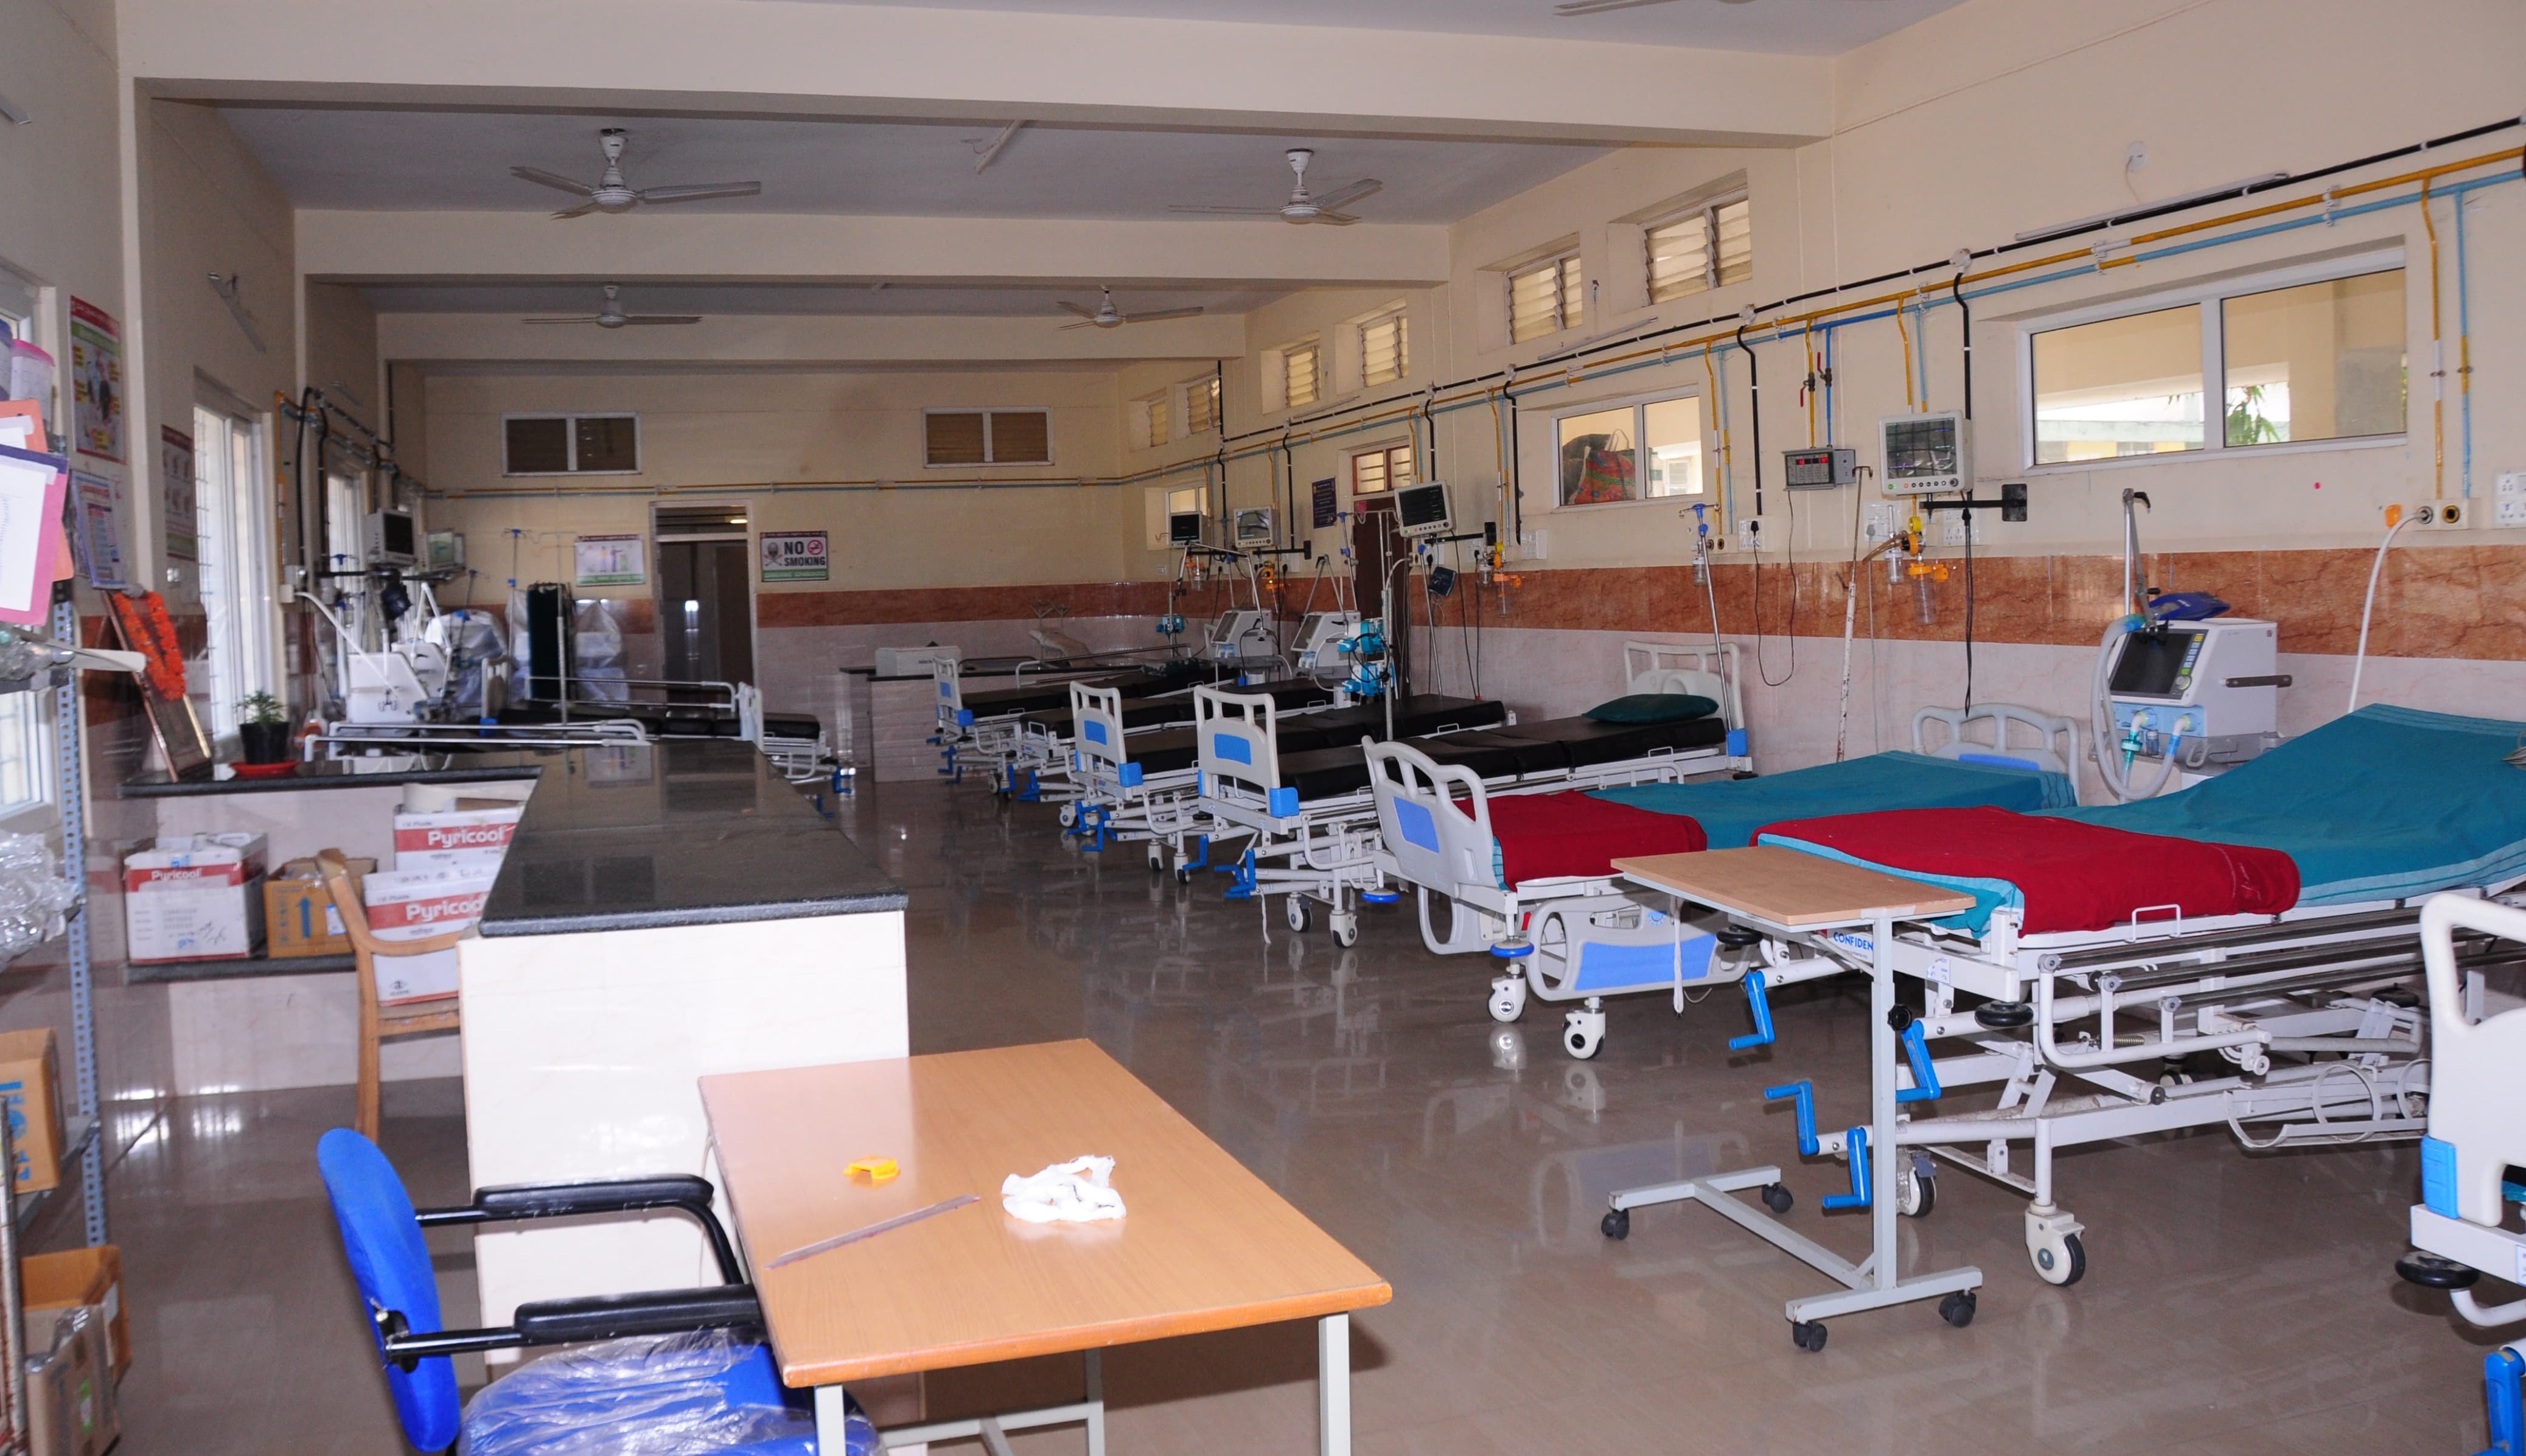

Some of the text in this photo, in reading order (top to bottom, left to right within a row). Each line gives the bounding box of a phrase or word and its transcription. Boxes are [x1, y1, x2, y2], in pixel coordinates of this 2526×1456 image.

[784, 541, 804, 555] NO
[784, 556, 825, 566] SMOKING
[428, 825, 504, 848] Pyricool
[152, 868, 201, 881] Pyricool
